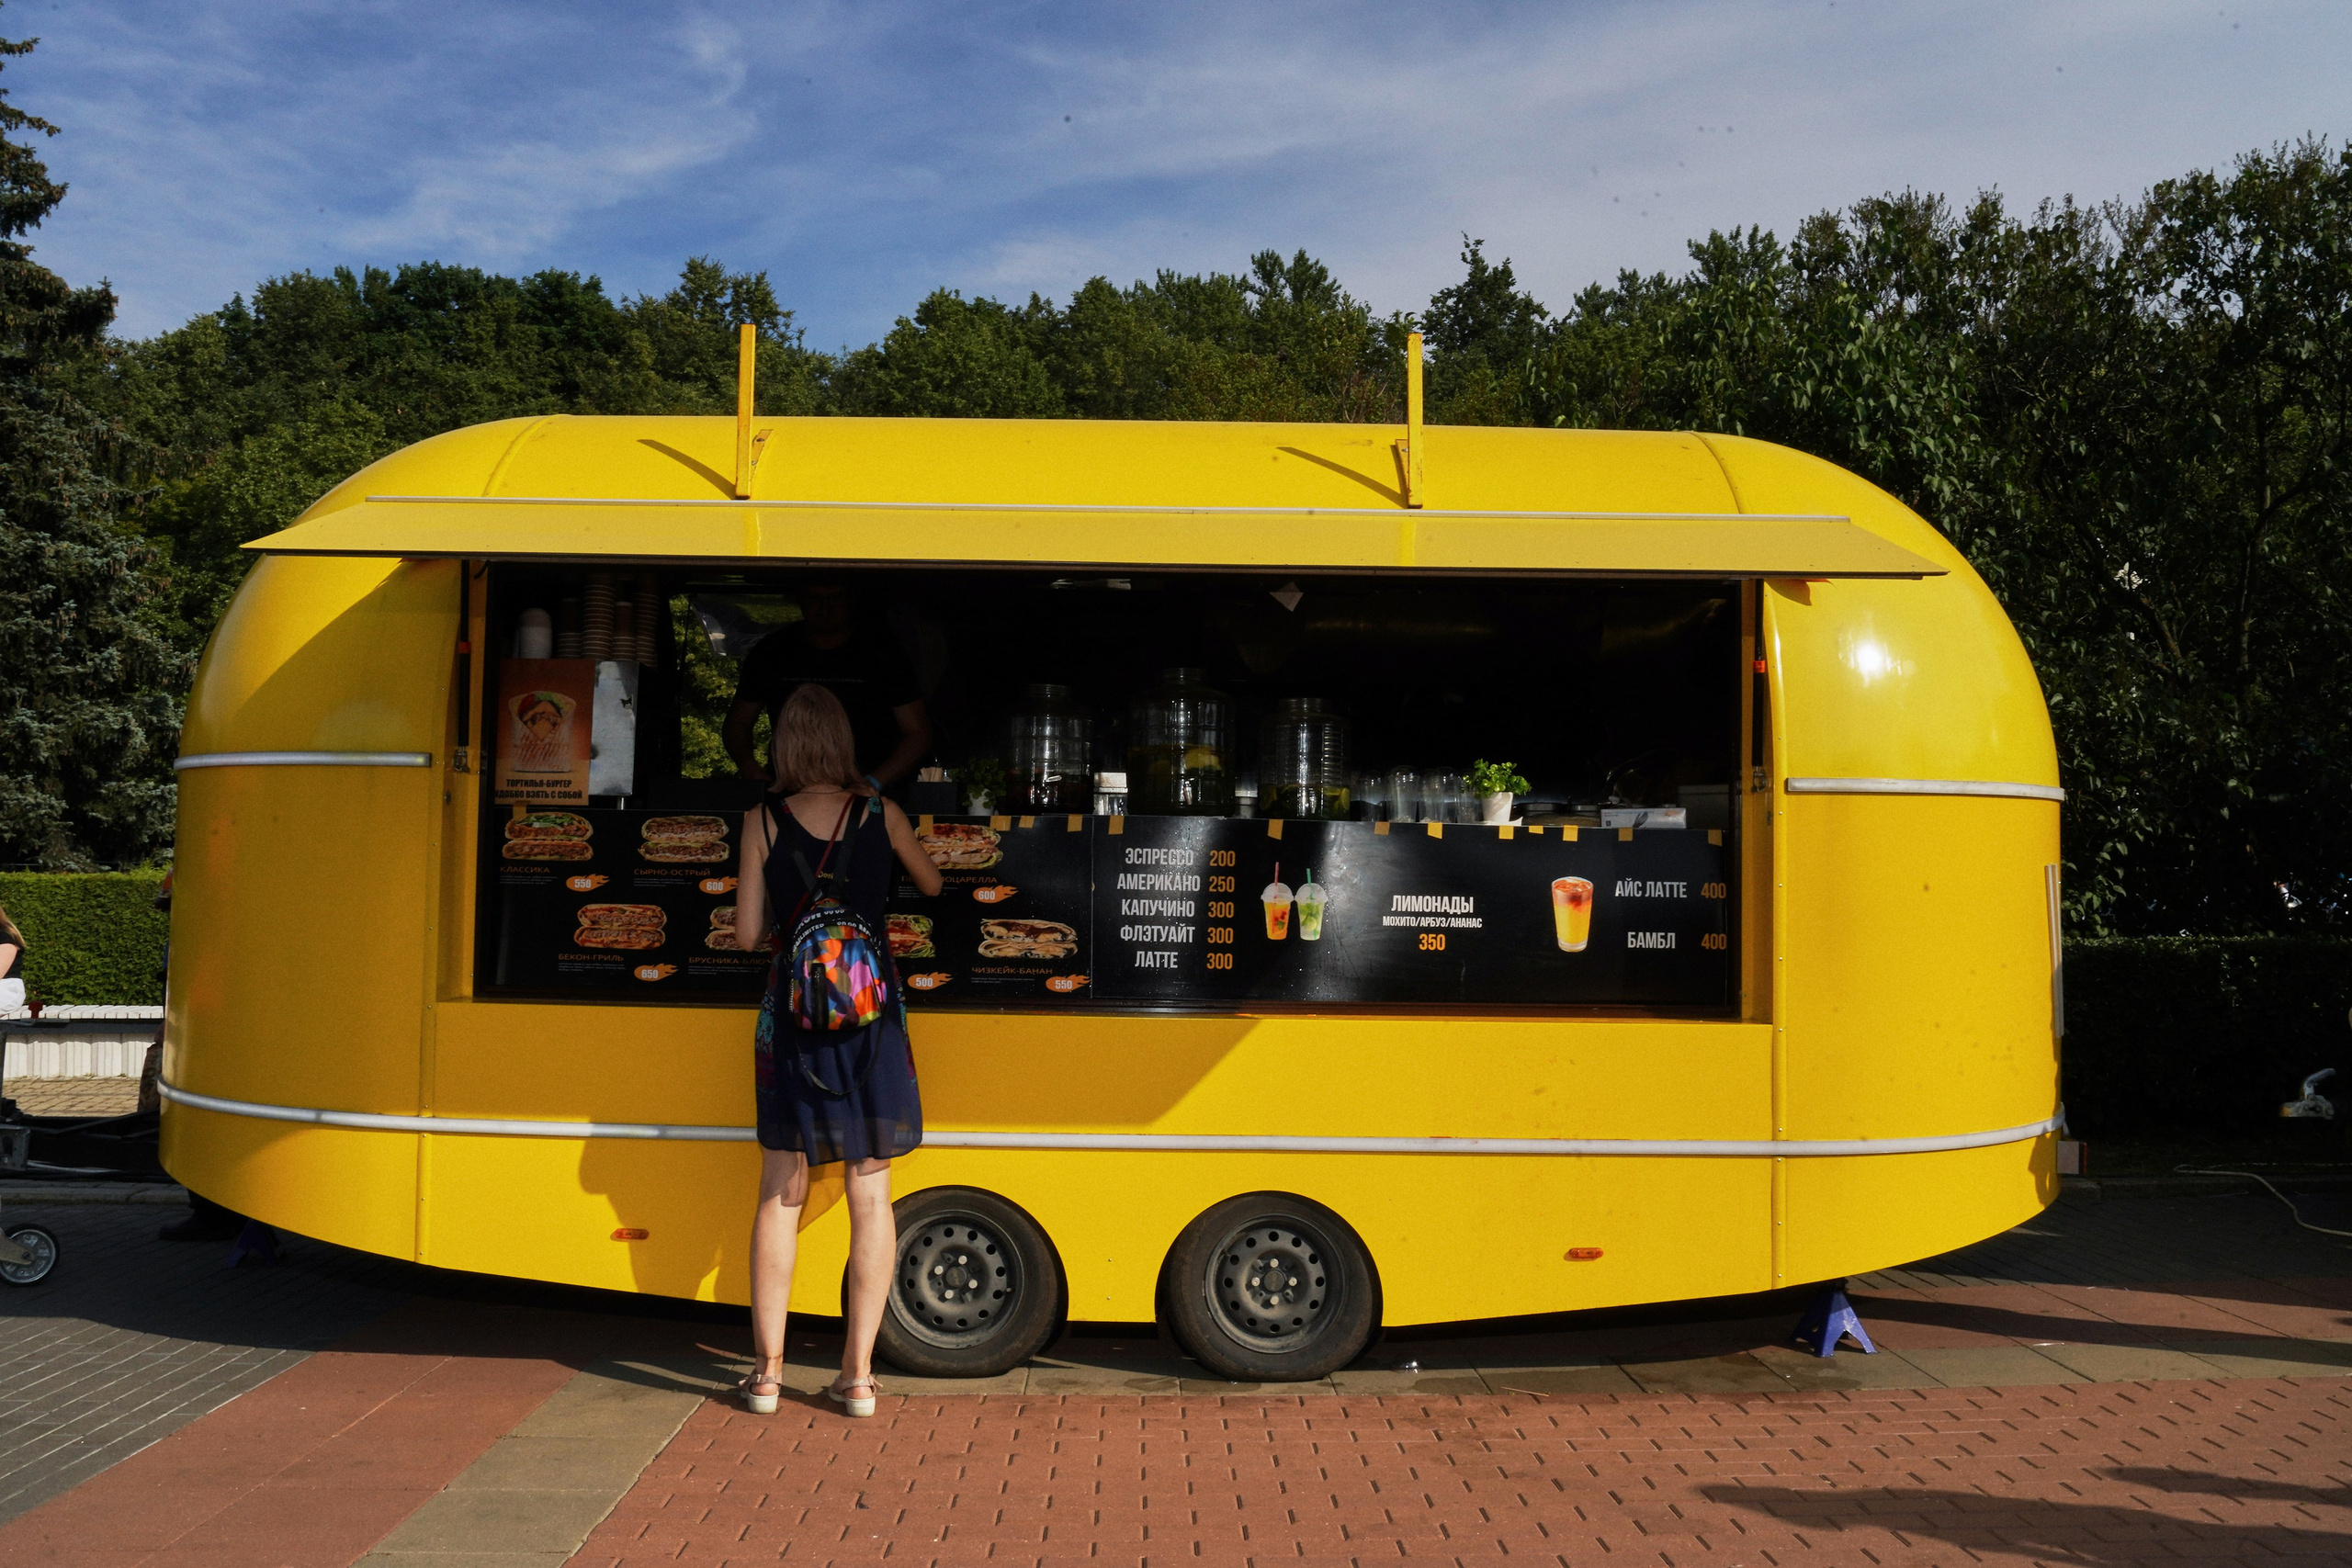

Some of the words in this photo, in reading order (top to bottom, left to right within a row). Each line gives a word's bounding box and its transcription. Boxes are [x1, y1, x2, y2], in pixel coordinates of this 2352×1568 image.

[506, 779, 571, 787] ТОРТИЛЬЯ-БУРГЕР
[526, 790, 549, 799] ВЗЯТЬ
[551, 790, 556, 798] С
[558, 790, 582, 799] СОБОЙ
[1125, 847, 1194, 865] ЭСПРЕССО
[1209, 850, 1236, 867] 200
[634, 868, 711, 876] СЫРНО-ОСТРЫЙ
[574, 879, 591, 888] 550
[706, 882, 723, 891] 600
[1116, 874, 1201, 892] АМЕРИКАНО
[1208, 875, 1235, 893] 250
[1614, 877, 1643, 897] АЙС
[1645, 881, 1688, 898] ЛАТТЕ
[1701, 882, 1726, 899] 400
[978, 890, 995, 900] 600
[1121, 898, 1195, 917] КАПУЧИНО
[1207, 901, 1234, 918] 300
[1391, 895, 1474, 915] ЛИМОНАДЫ
[1382, 916, 1483, 929] МОХИТО/АРБУЗ/АНАНАС
[1120, 923, 1195, 943] ФЛЭТУАЙТ
[1207, 927, 1234, 943] 300
[1419, 933, 1446, 951] 350
[1627, 931, 1676, 949] БАМБЛ
[1701, 933, 1727, 950] 400
[558, 953, 624, 962] БЕКОН-ГРИЛЬ
[1134, 951, 1179, 968] ЛАТТЕ
[1206, 953, 1233, 970] 300
[641, 969, 659, 979] 650
[971, 966, 1053, 975] ЧИЗКЕЙК-БАНАН
[915, 977, 933, 987] 500
[1055, 979, 1073, 989] 550
